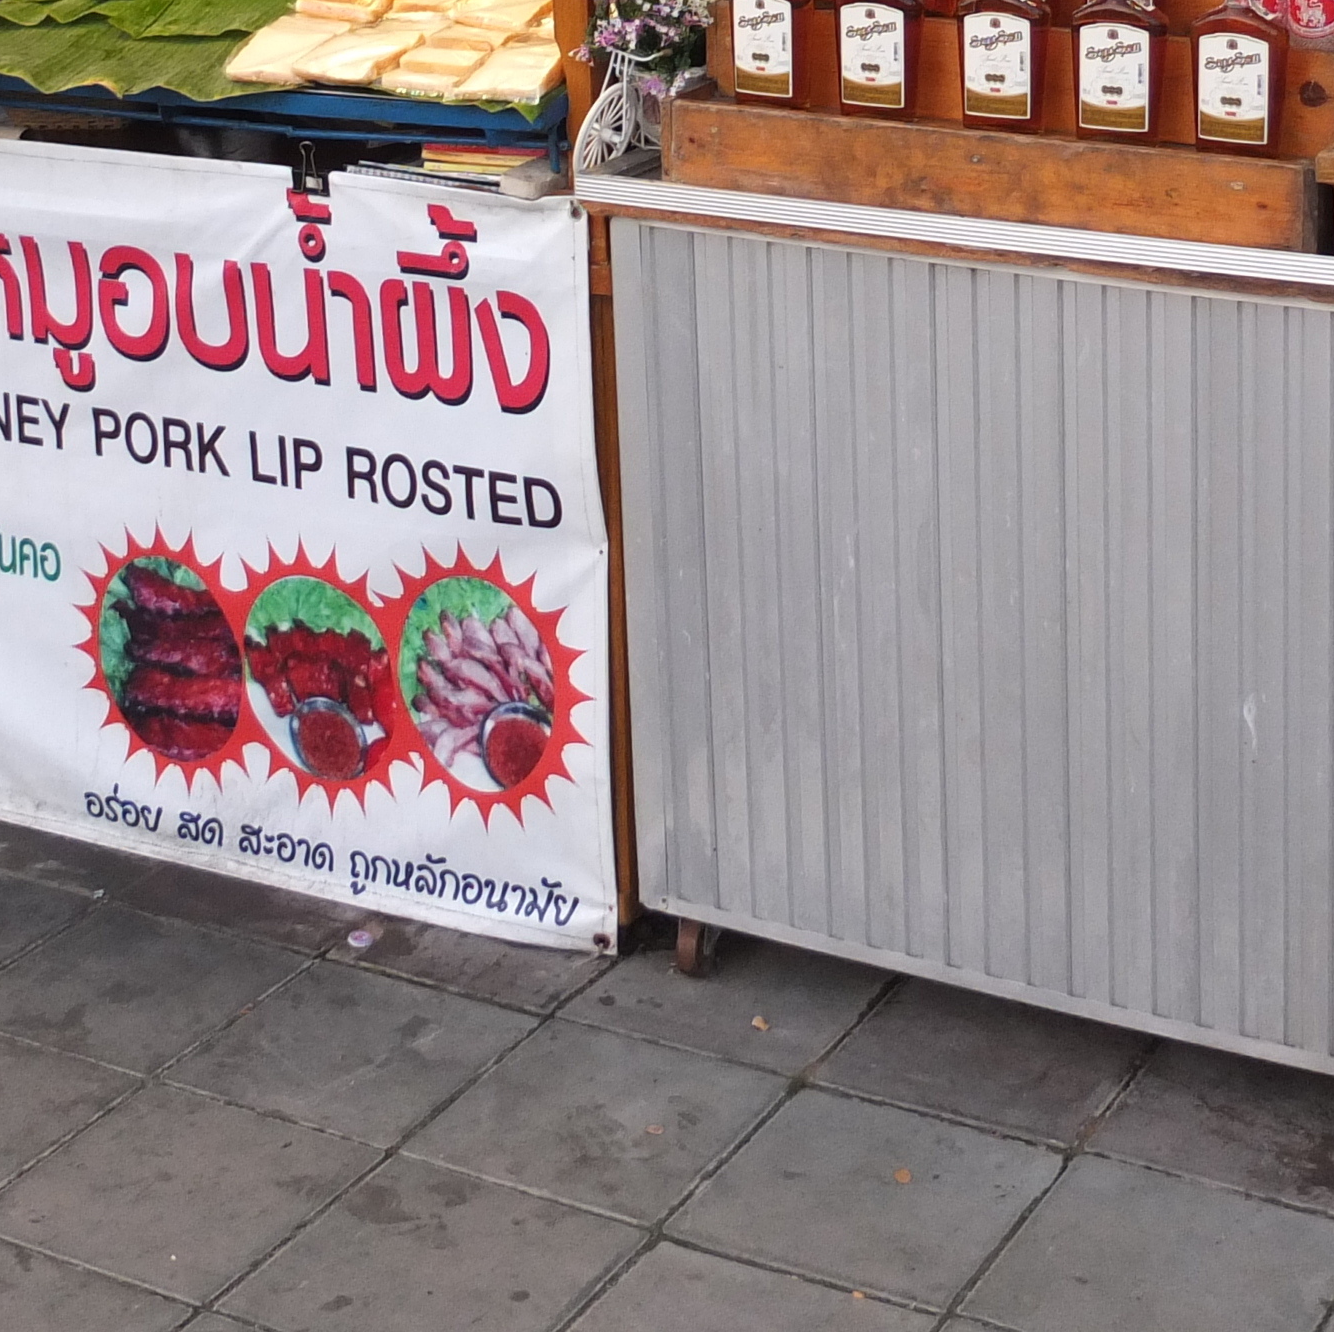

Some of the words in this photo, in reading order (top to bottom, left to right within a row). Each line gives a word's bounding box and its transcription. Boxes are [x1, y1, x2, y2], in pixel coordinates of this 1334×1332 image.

[95, 407, 229, 476] PORK
[249, 429, 323, 487] LIP
[346, 446, 563, 528] ROSTED
[84, 784, 163, 833] อร่อย
[177, 811, 223, 847] สด
[238, 823, 334, 872] สะอาด
[349, 849, 579, 927] ถูกหลักอนามัย
